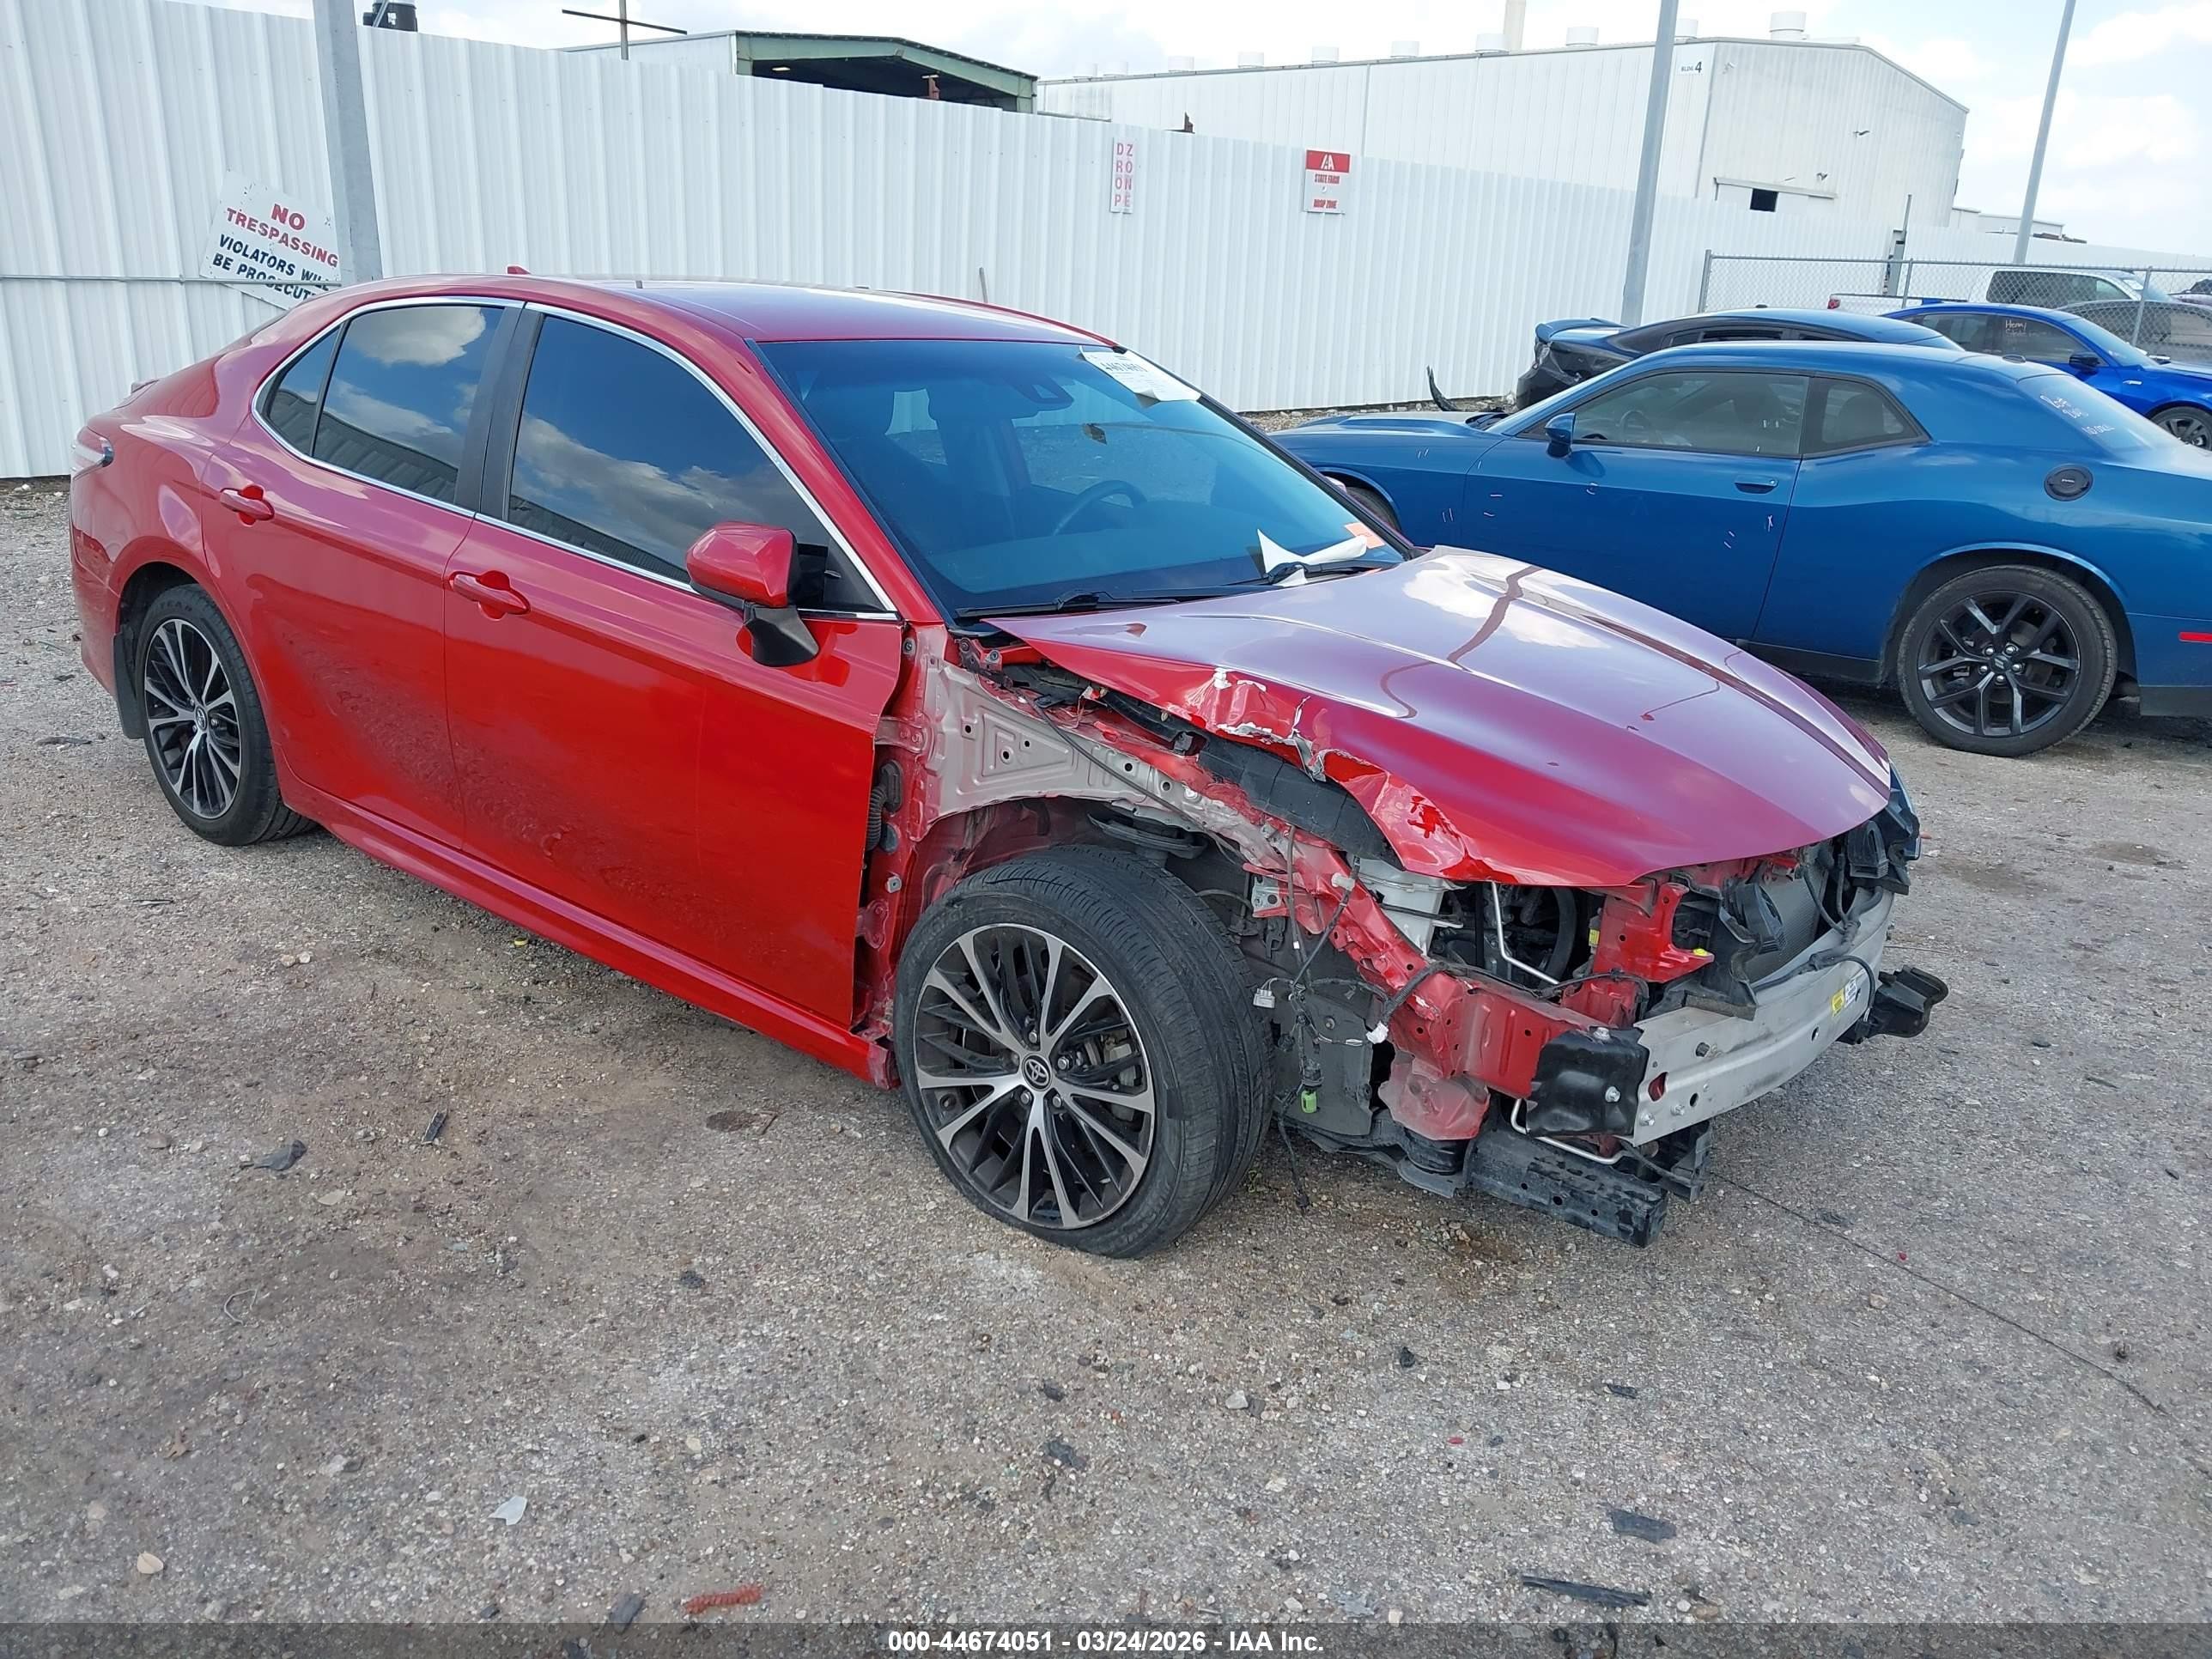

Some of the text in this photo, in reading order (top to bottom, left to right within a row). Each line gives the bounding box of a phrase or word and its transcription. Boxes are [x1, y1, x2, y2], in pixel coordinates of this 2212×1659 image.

[1694, 61, 1702, 73] 4
[270, 204, 306, 231] NO
[226, 207, 338, 268] TRESPASSING
[212, 252, 234, 271] BE
[219, 234, 296, 276] VIOLATORS
